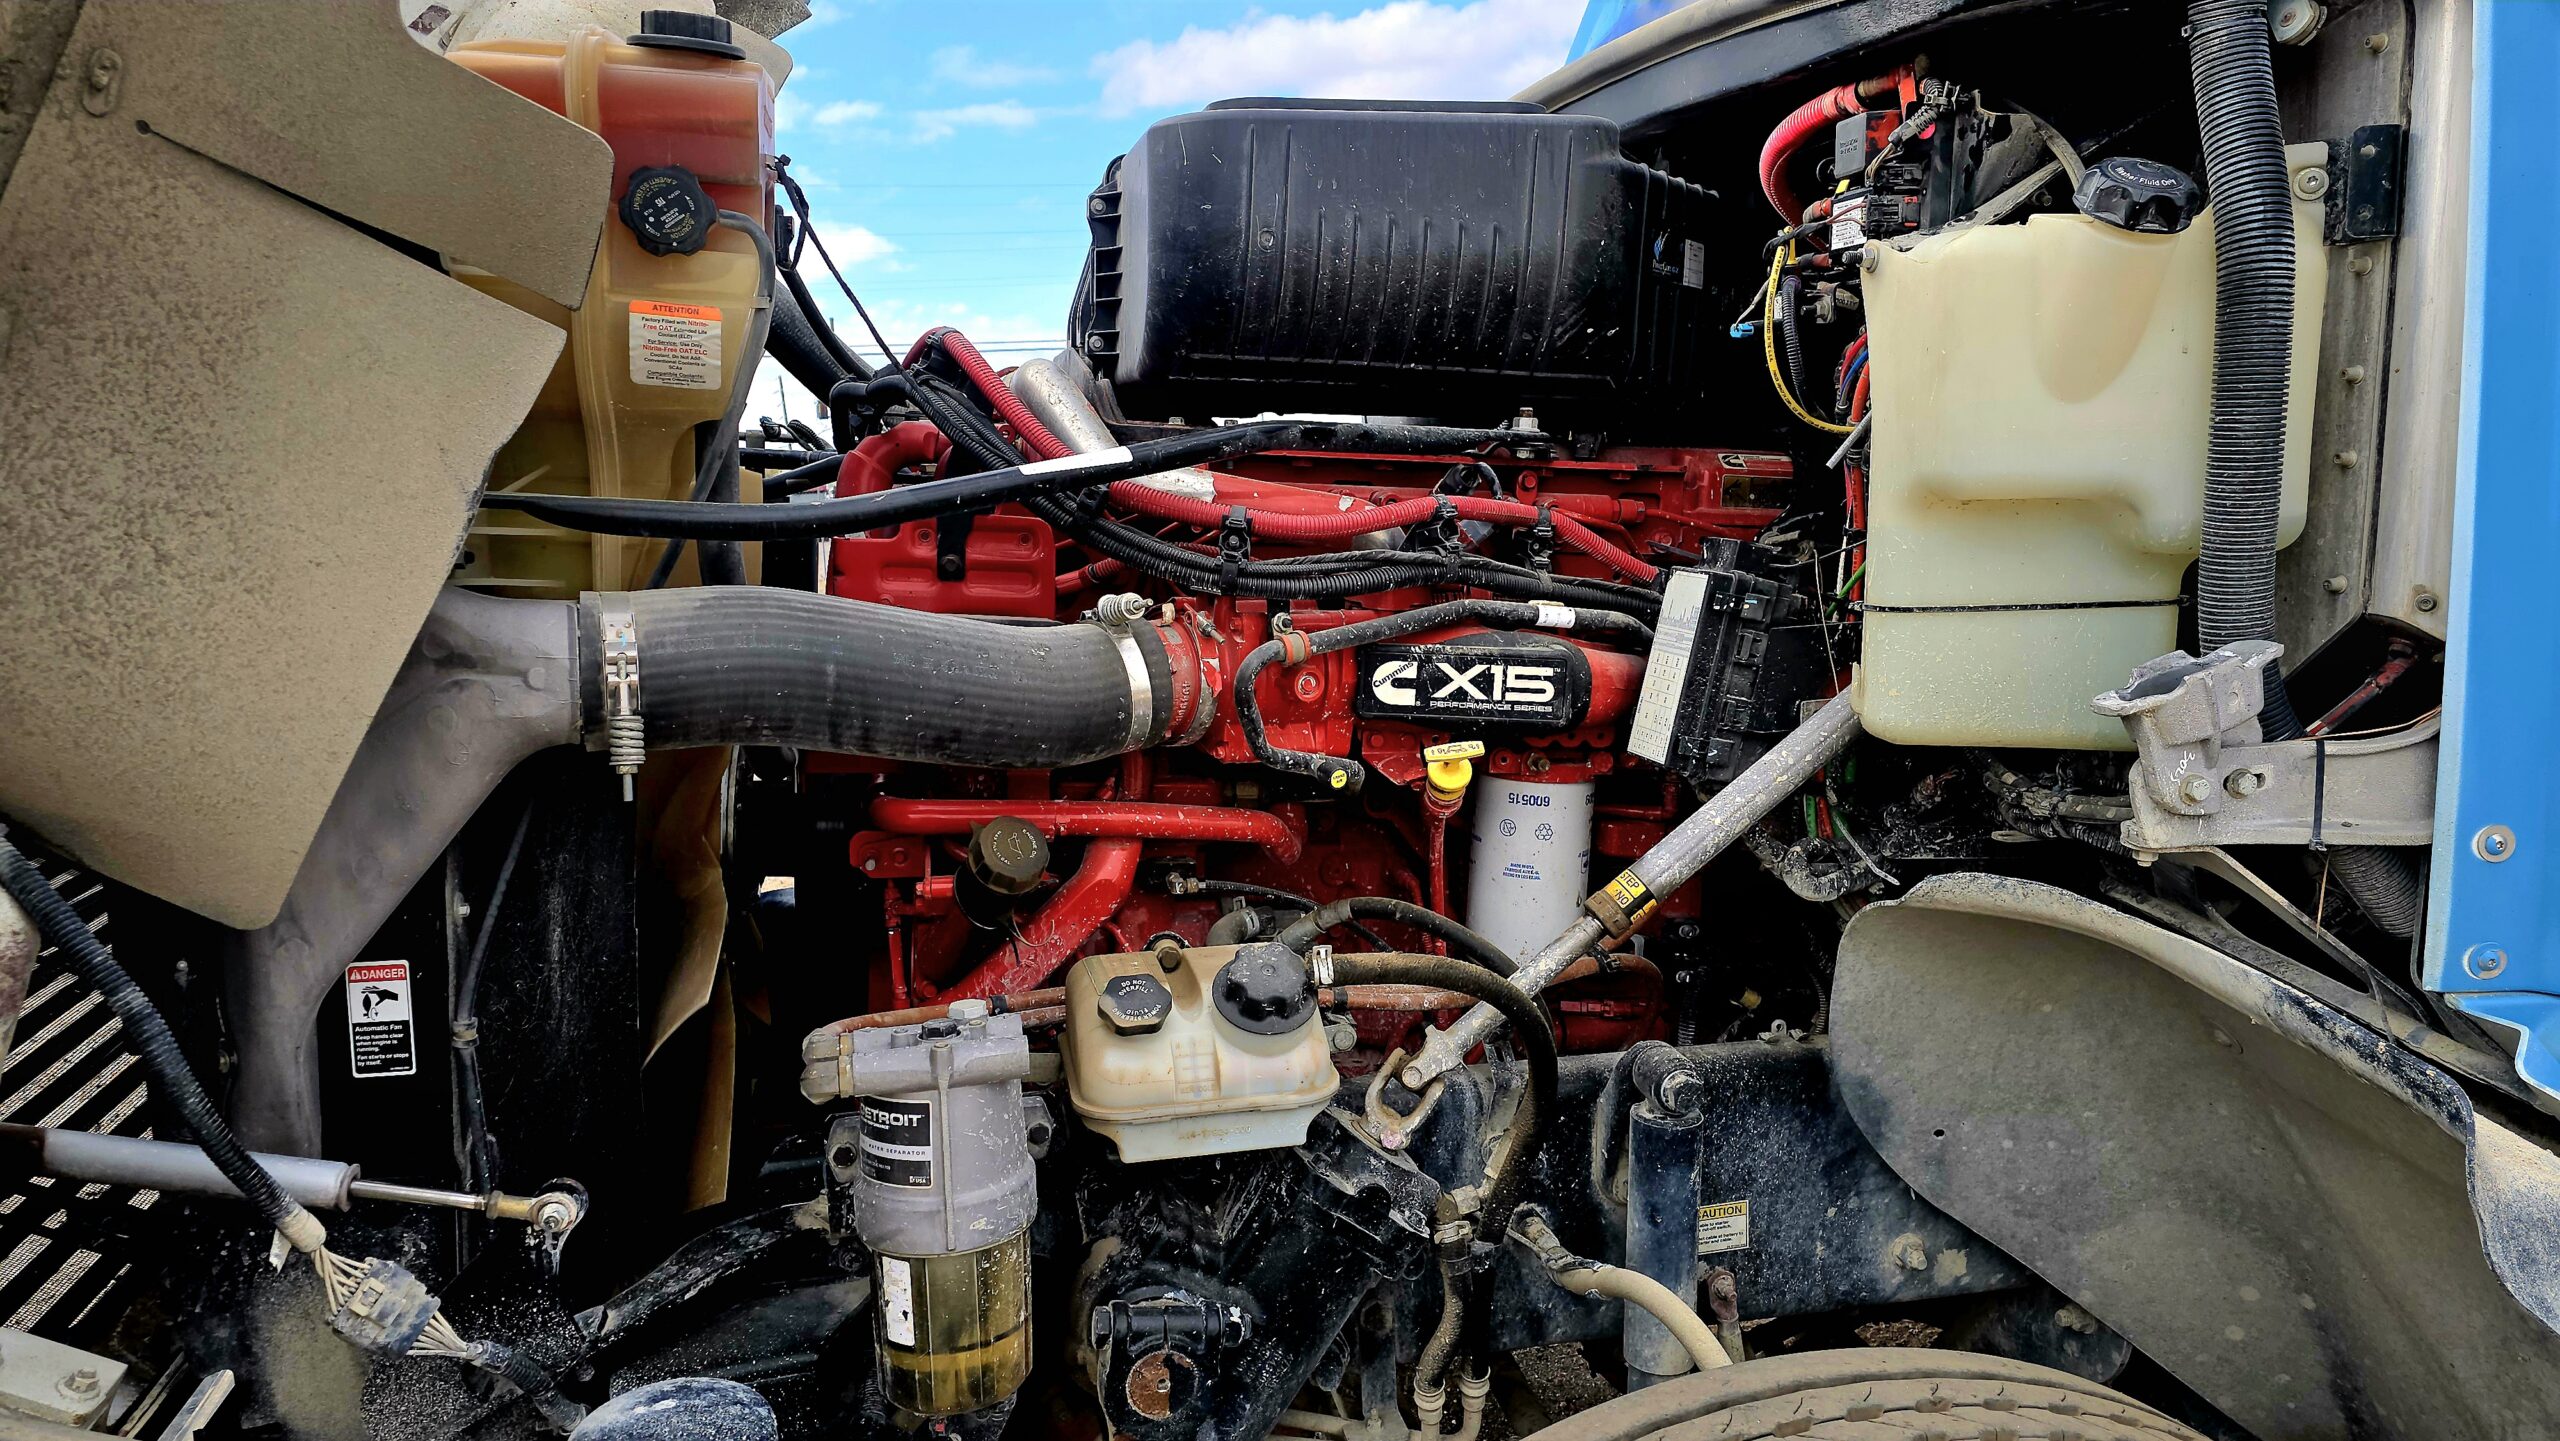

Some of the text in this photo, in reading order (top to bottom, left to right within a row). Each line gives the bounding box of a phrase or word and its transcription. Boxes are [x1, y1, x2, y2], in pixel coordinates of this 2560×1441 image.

[2139, 177, 2160, 185] Fluid
[670, 224, 692, 239] CAUTION
[652, 304, 699, 315] ATTENTION
[643, 344, 678, 353] Nitrite-Free
[1373, 662, 1555, 703] Cummins X15
[1429, 700, 1553, 713] PERFORMANCE SERIES
[1508, 792, 1551, 807] 600515
[1022, 828, 1038, 858] ENGINE OIL
[1620, 872, 1640, 888] STEP
[1616, 890, 1630, 905] NO
[361, 968, 405, 980] DANGER
[1118, 985, 1149, 996] OVERFILL
[1112, 1004, 1162, 1021] POWER STEERING
[1126, 1007, 1149, 1015] FLUID
[868, 1143, 926, 1156] WATER SEPARATOR
